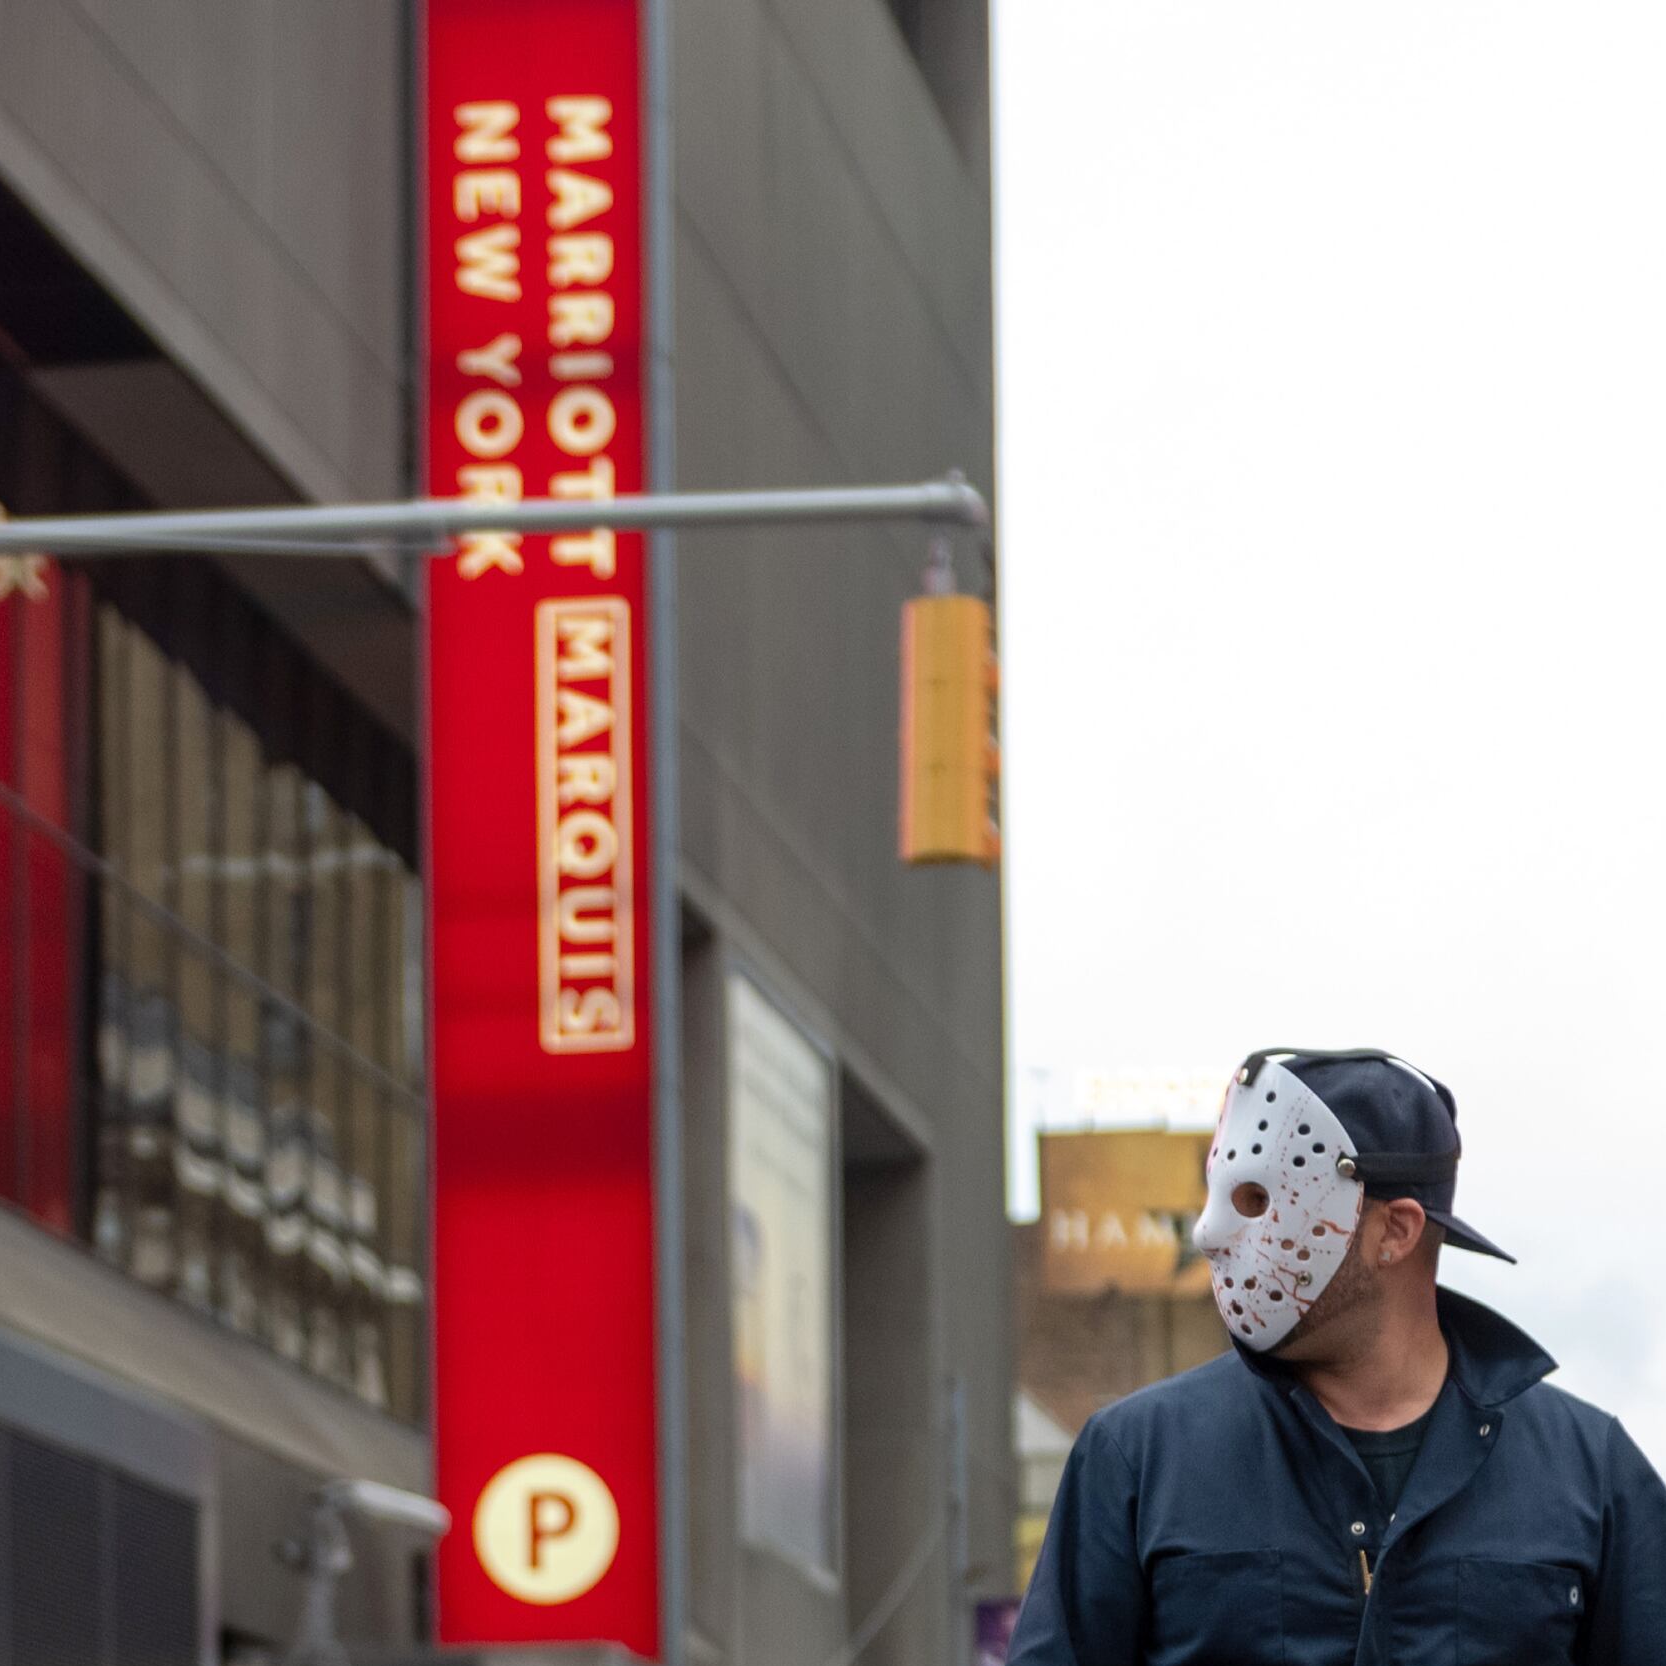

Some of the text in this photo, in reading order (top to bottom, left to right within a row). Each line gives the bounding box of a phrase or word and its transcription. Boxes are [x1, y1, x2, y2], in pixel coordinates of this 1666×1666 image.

[453, 99, 525, 581] NEW YORK
[545, 95, 620, 1034] MARRIOTT MARQUIS
[525, 1486, 577, 1572] P
